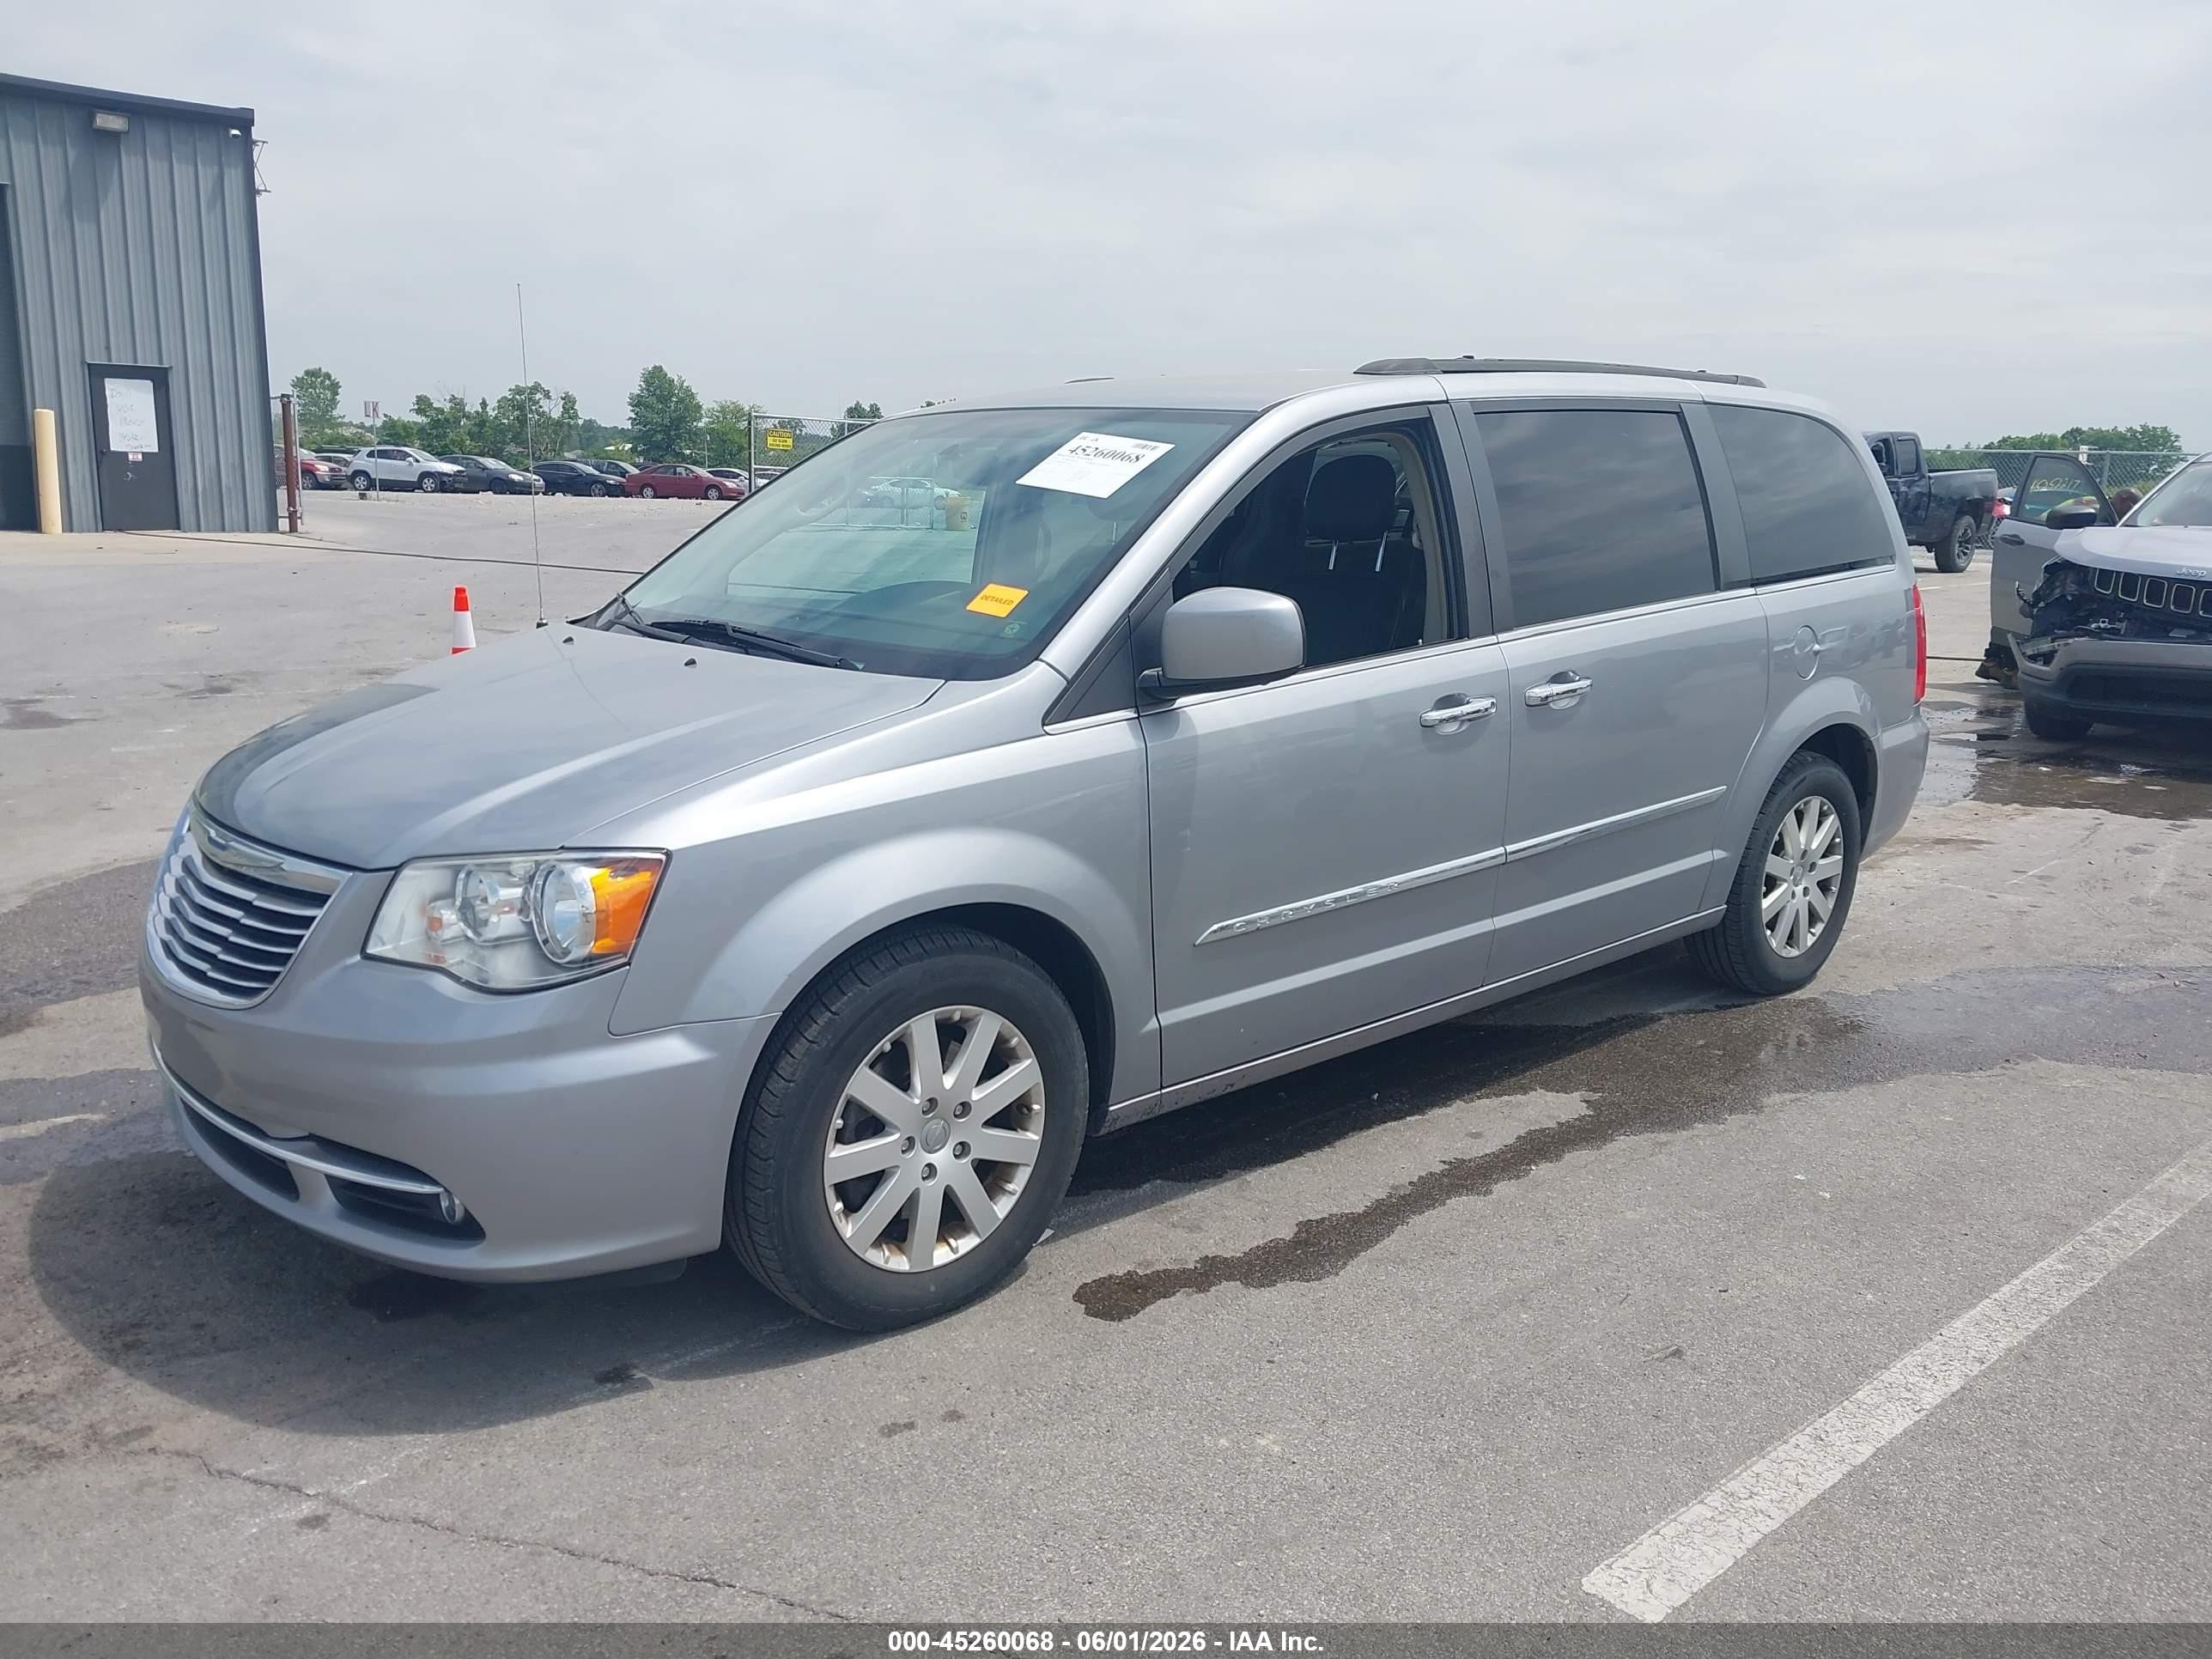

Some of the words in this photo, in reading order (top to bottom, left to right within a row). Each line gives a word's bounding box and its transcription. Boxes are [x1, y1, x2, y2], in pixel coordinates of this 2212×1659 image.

[1068, 445, 1146, 464] 45260068
[2175, 568, 2208, 578] Jeep
[1233, 881, 1401, 933] CHRYSLER
